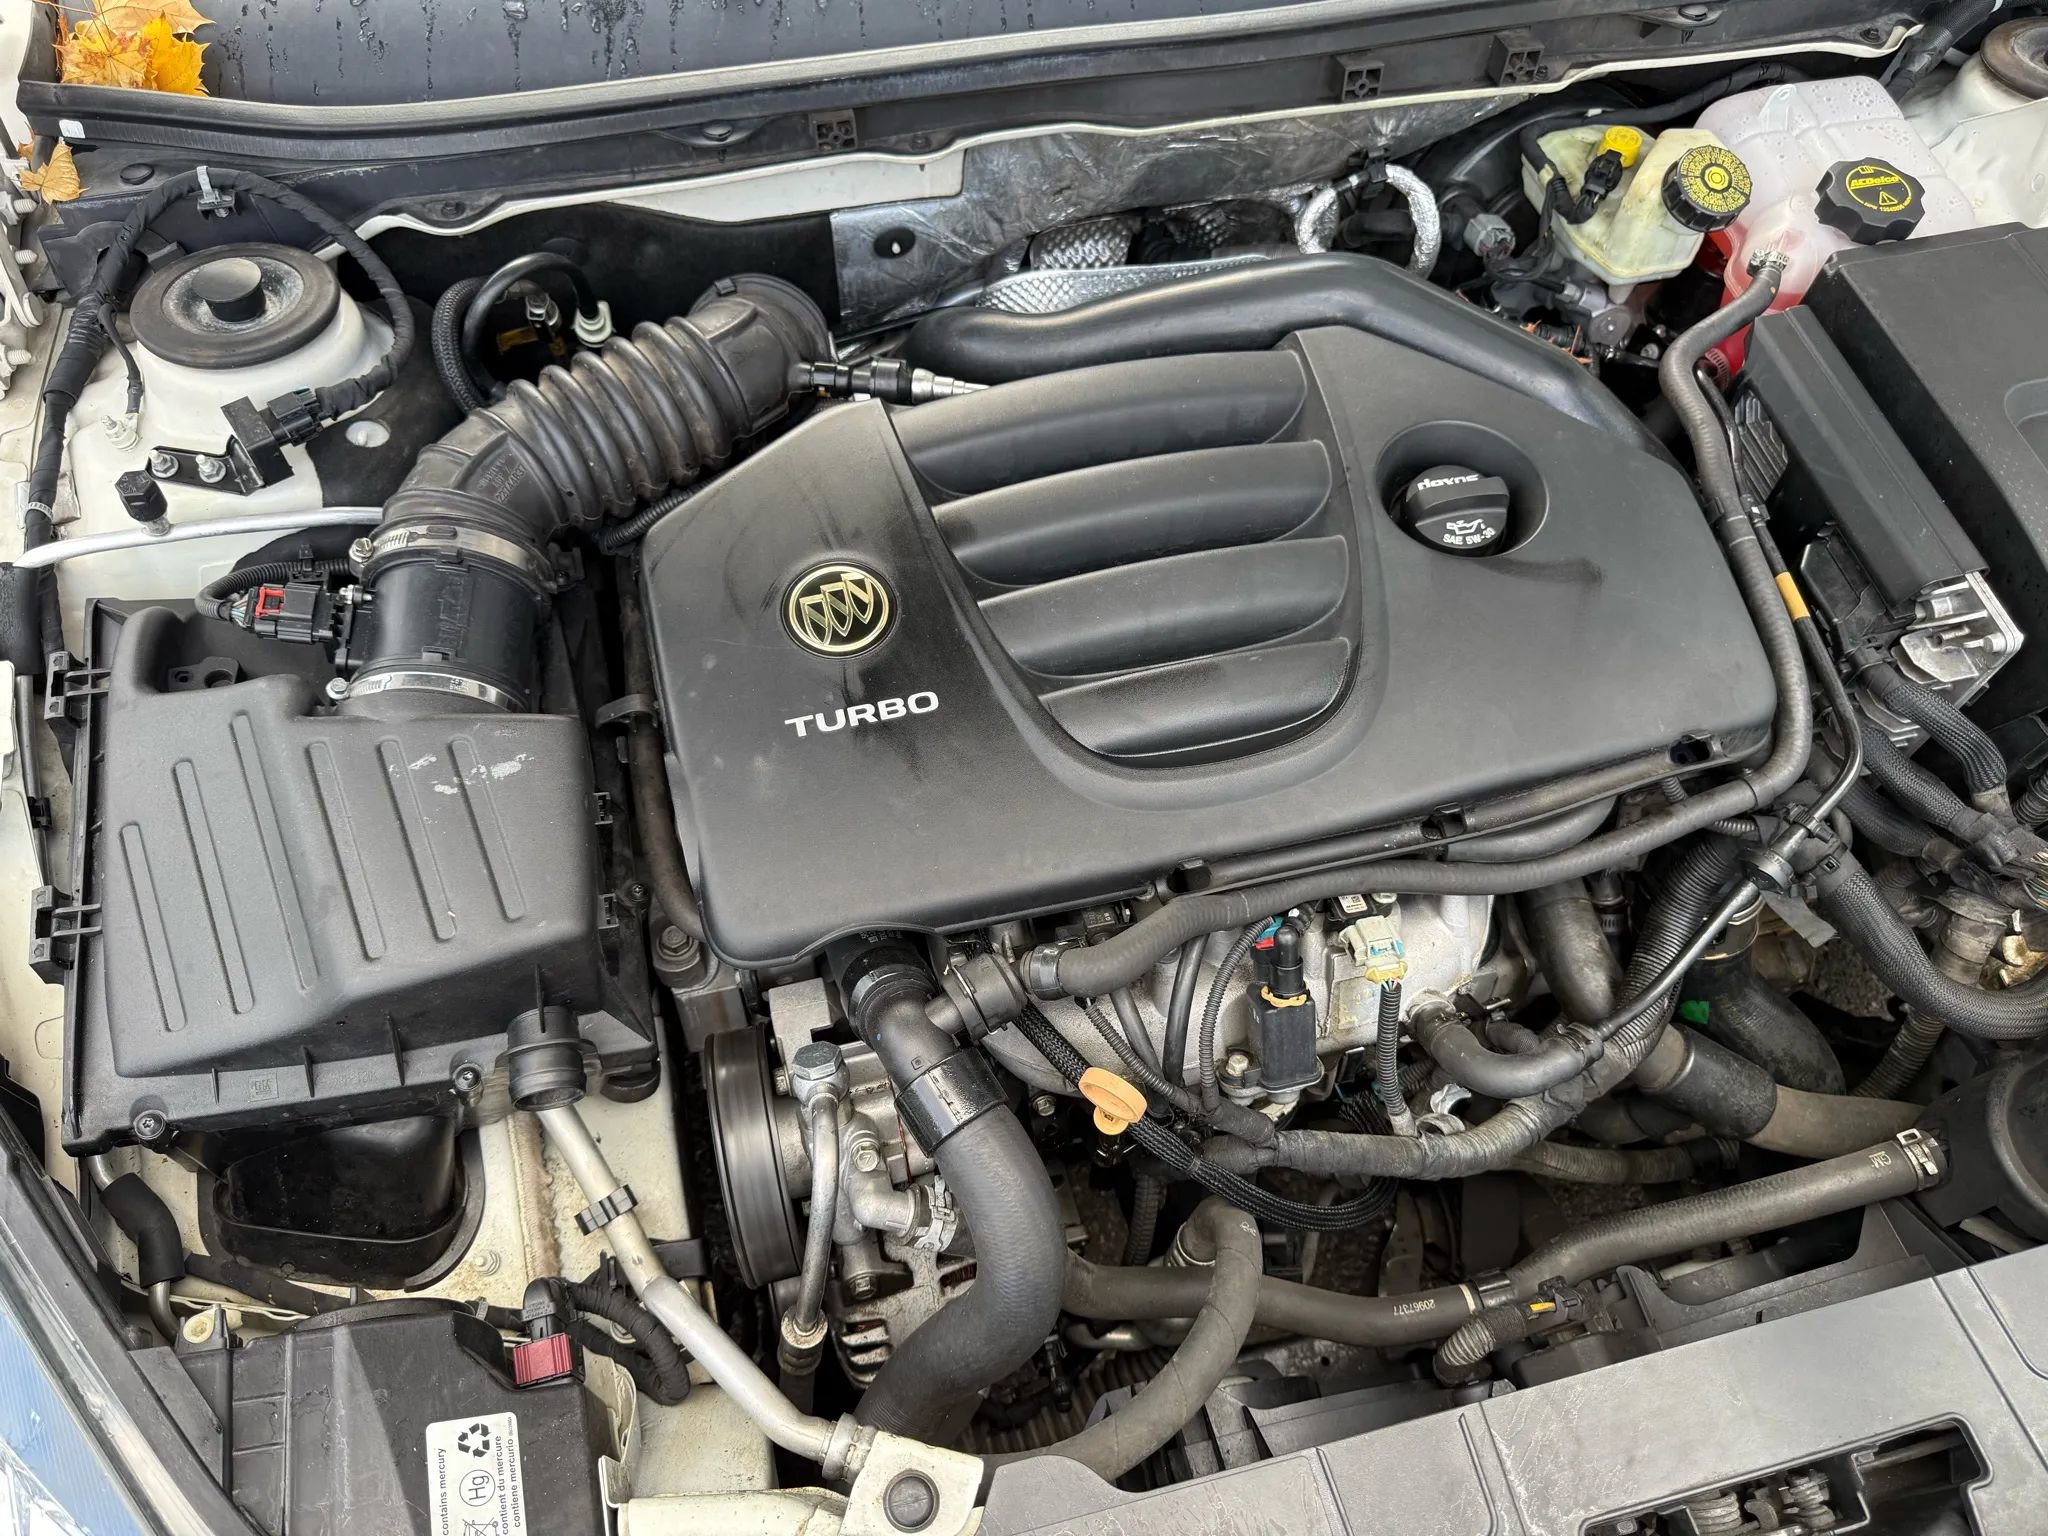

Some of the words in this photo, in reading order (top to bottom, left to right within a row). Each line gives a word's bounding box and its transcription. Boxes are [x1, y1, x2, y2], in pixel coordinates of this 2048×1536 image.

[1850, 176, 1899, 187] ACDelco
[1443, 533, 1463, 545] SAE
[1465, 526, 1496, 545] 5W-30
[784, 691, 939, 737] TURBO
[1393, 1298, 1436, 1316] 20967377
[437, 1448, 447, 1490] mercury
[496, 1435, 505, 1476] mercure
[506, 1438, 517, 1482] mercurio
[468, 1475, 490, 1501] Hg
[497, 1479, 506, 1492] du
[437, 1492, 449, 1536] contains
[498, 1494, 508, 1535] contient
[510, 1485, 521, 1528] contiene
